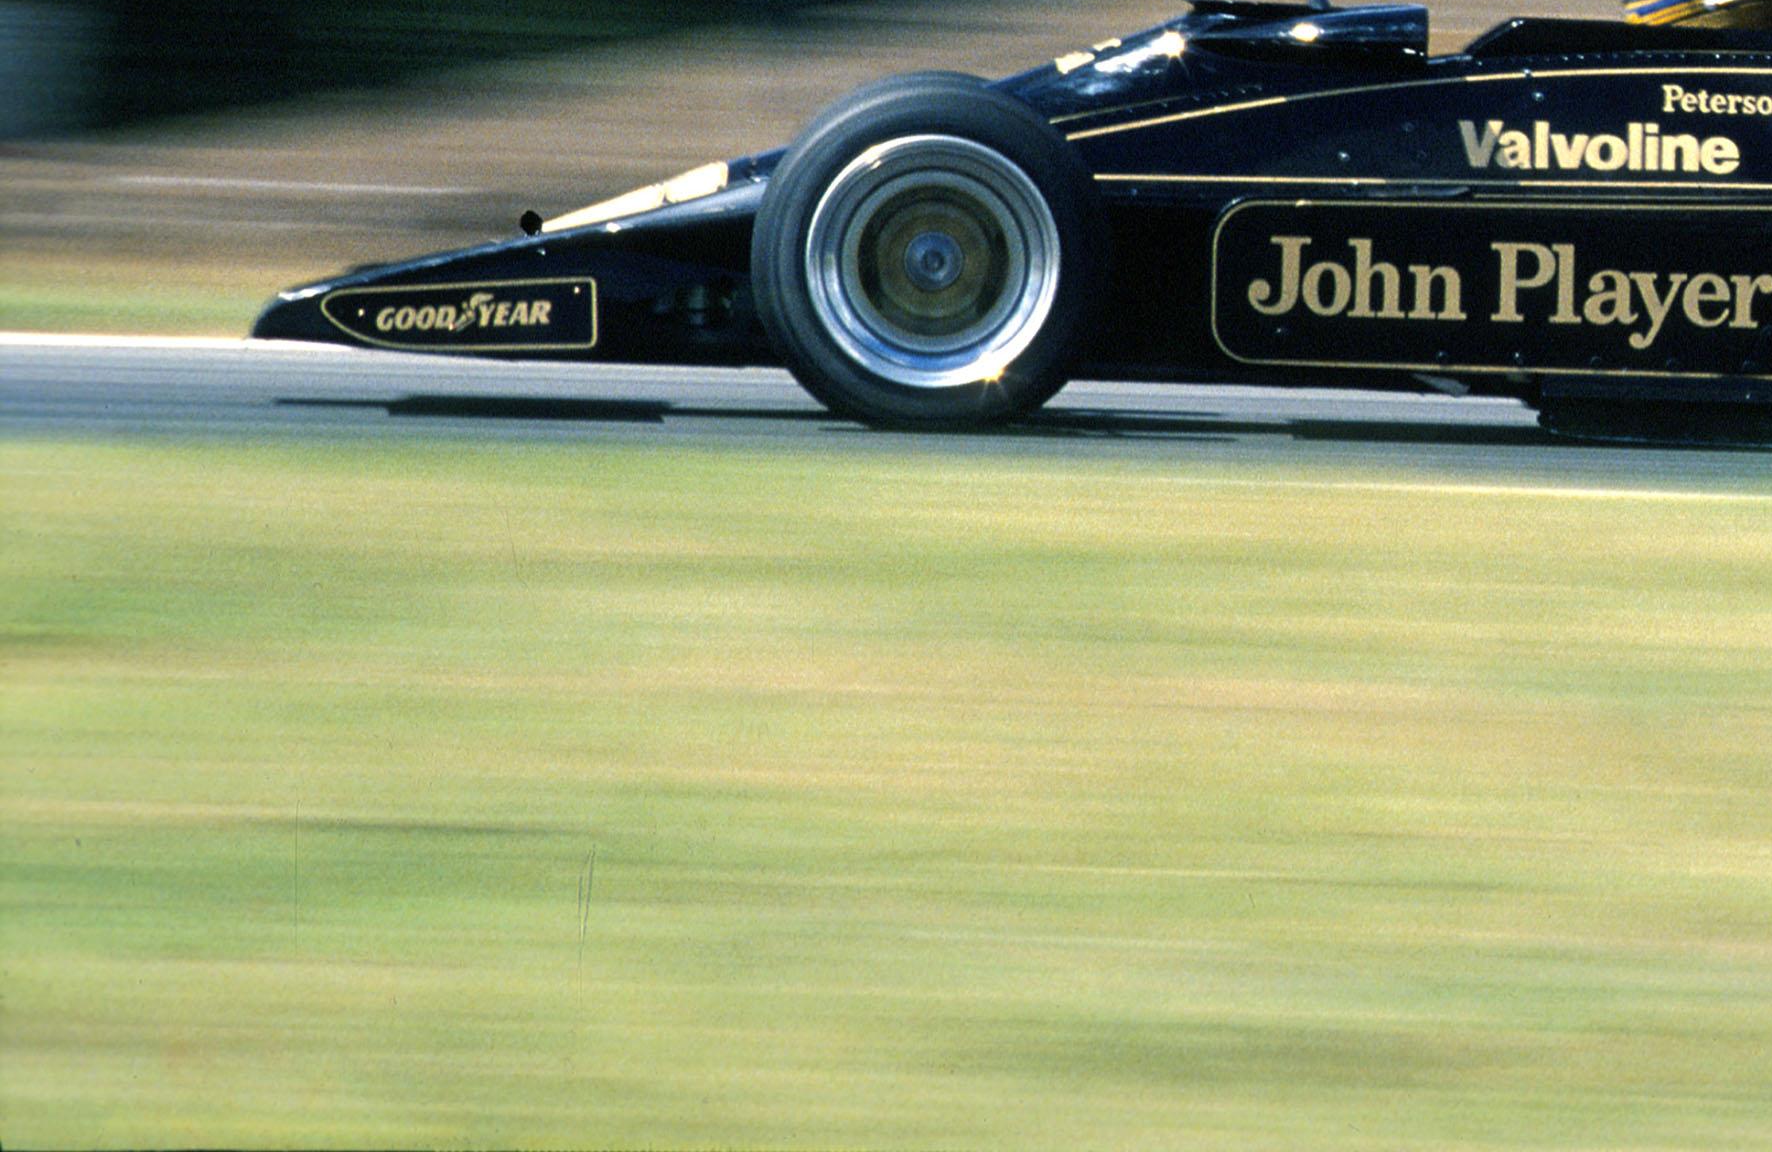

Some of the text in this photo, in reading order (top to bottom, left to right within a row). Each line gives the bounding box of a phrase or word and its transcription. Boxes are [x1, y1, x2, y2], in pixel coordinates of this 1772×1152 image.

[1458, 120, 1741, 175] Valvoline
[1248, 236, 1467, 321] John
[376, 299, 552, 332] GOODYEAR
